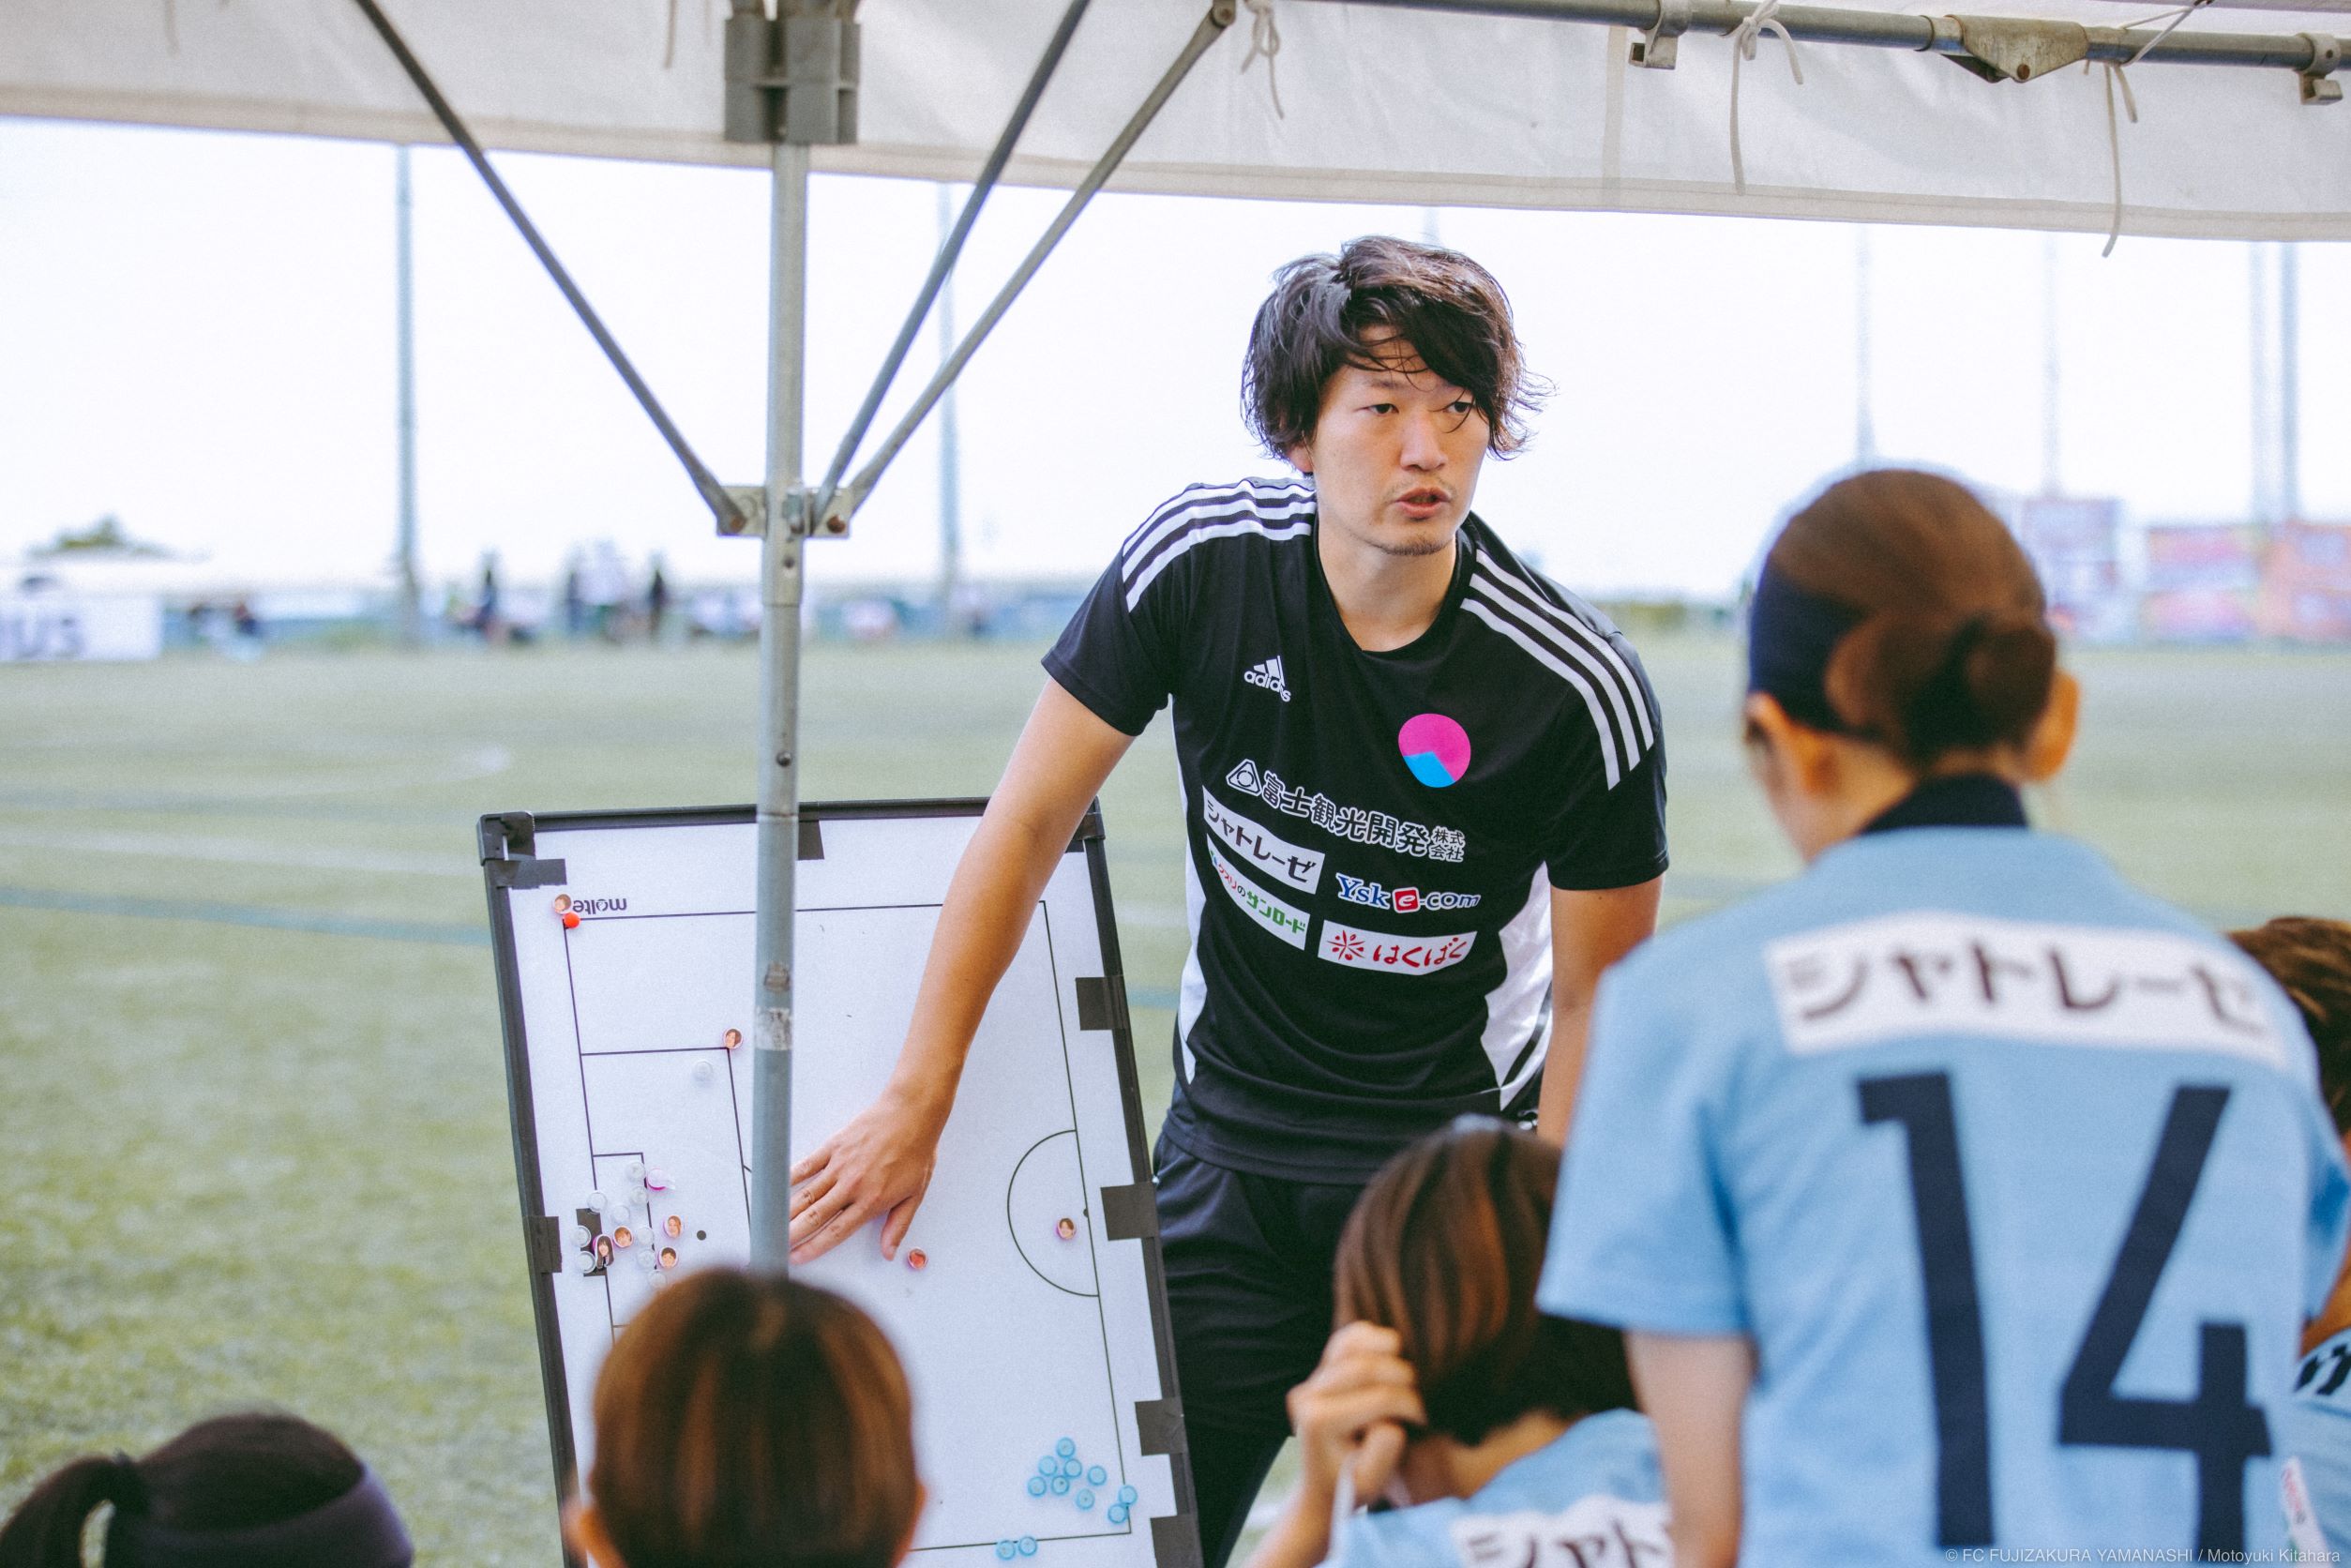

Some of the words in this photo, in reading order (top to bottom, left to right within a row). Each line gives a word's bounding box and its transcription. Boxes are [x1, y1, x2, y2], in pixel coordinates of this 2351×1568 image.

[1207, 799, 1317, 883] シャトレーゼ
[572, 897, 627, 915] molte
[1336, 873, 1390, 909] Ysk
[1857, 1070, 2272, 1568] 14
